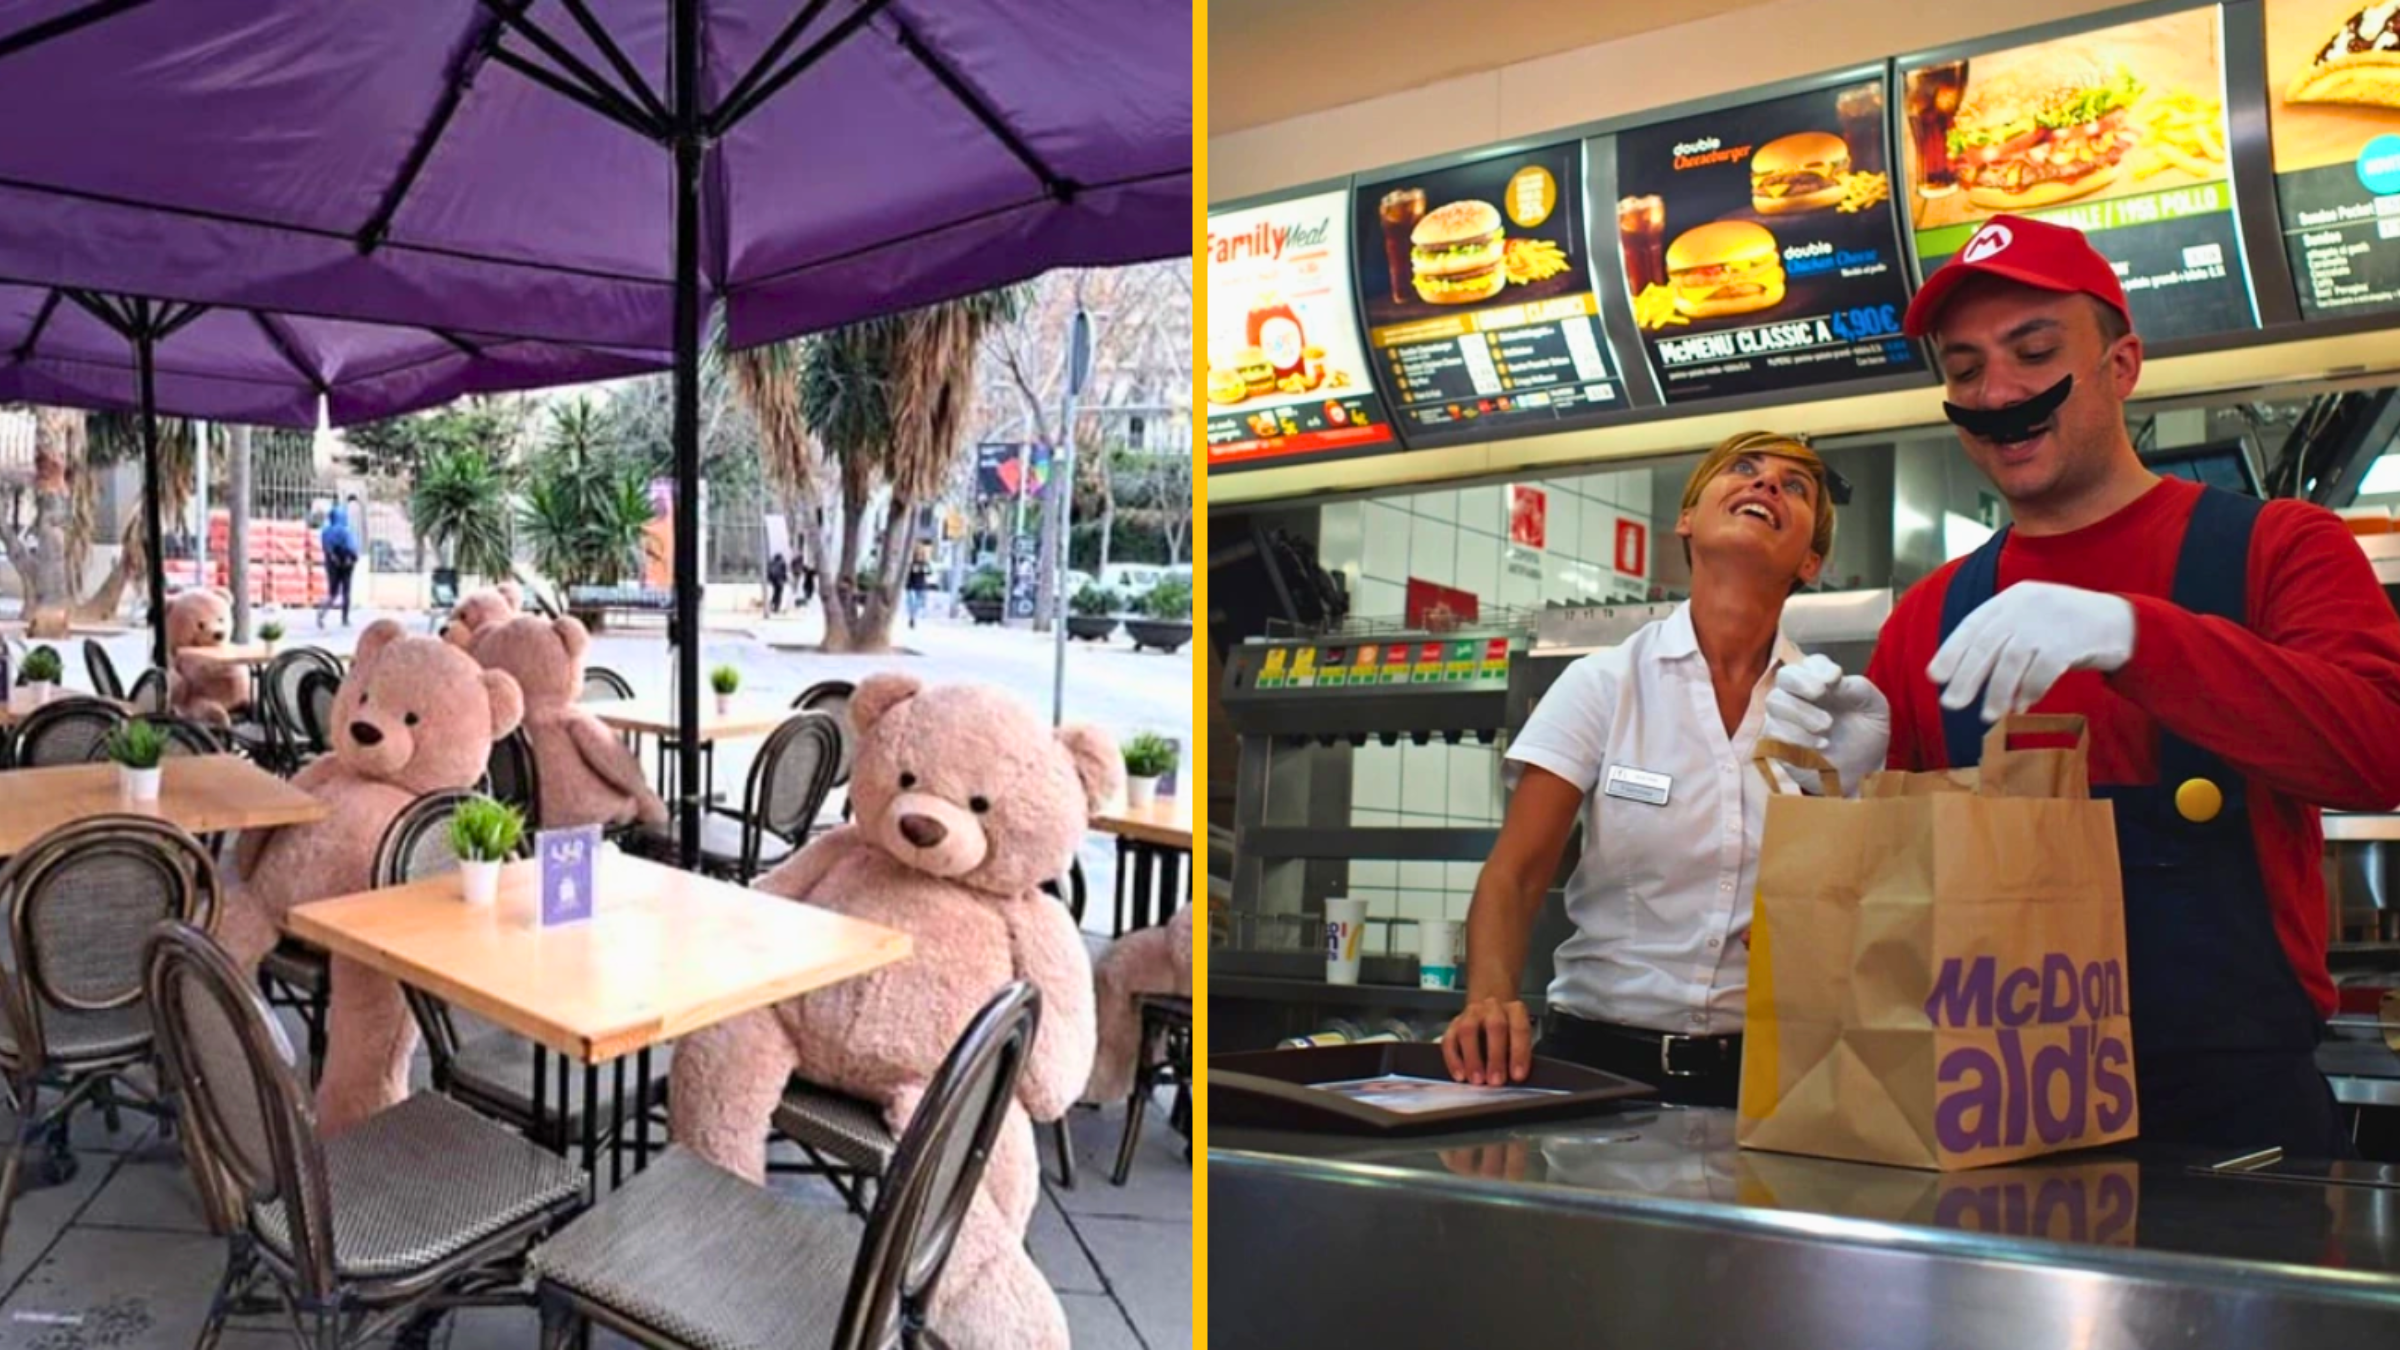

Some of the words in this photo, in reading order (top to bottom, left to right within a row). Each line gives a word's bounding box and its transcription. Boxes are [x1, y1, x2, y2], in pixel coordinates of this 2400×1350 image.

[1673, 136, 1721, 157] double
[1674, 144, 1752, 170] Cheeseburger
[2160, 185, 2218, 217] POLLO
[1285, 217, 1329, 249] Meal
[1783, 240, 1833, 261] double
[1735, 320, 1813, 354] CLASSIC
[1815, 319, 1832, 342] A
[1832, 303, 1899, 343] 4,90€
[1924, 952, 2124, 1028] McDon
[1934, 1023, 2133, 1154] ald's
